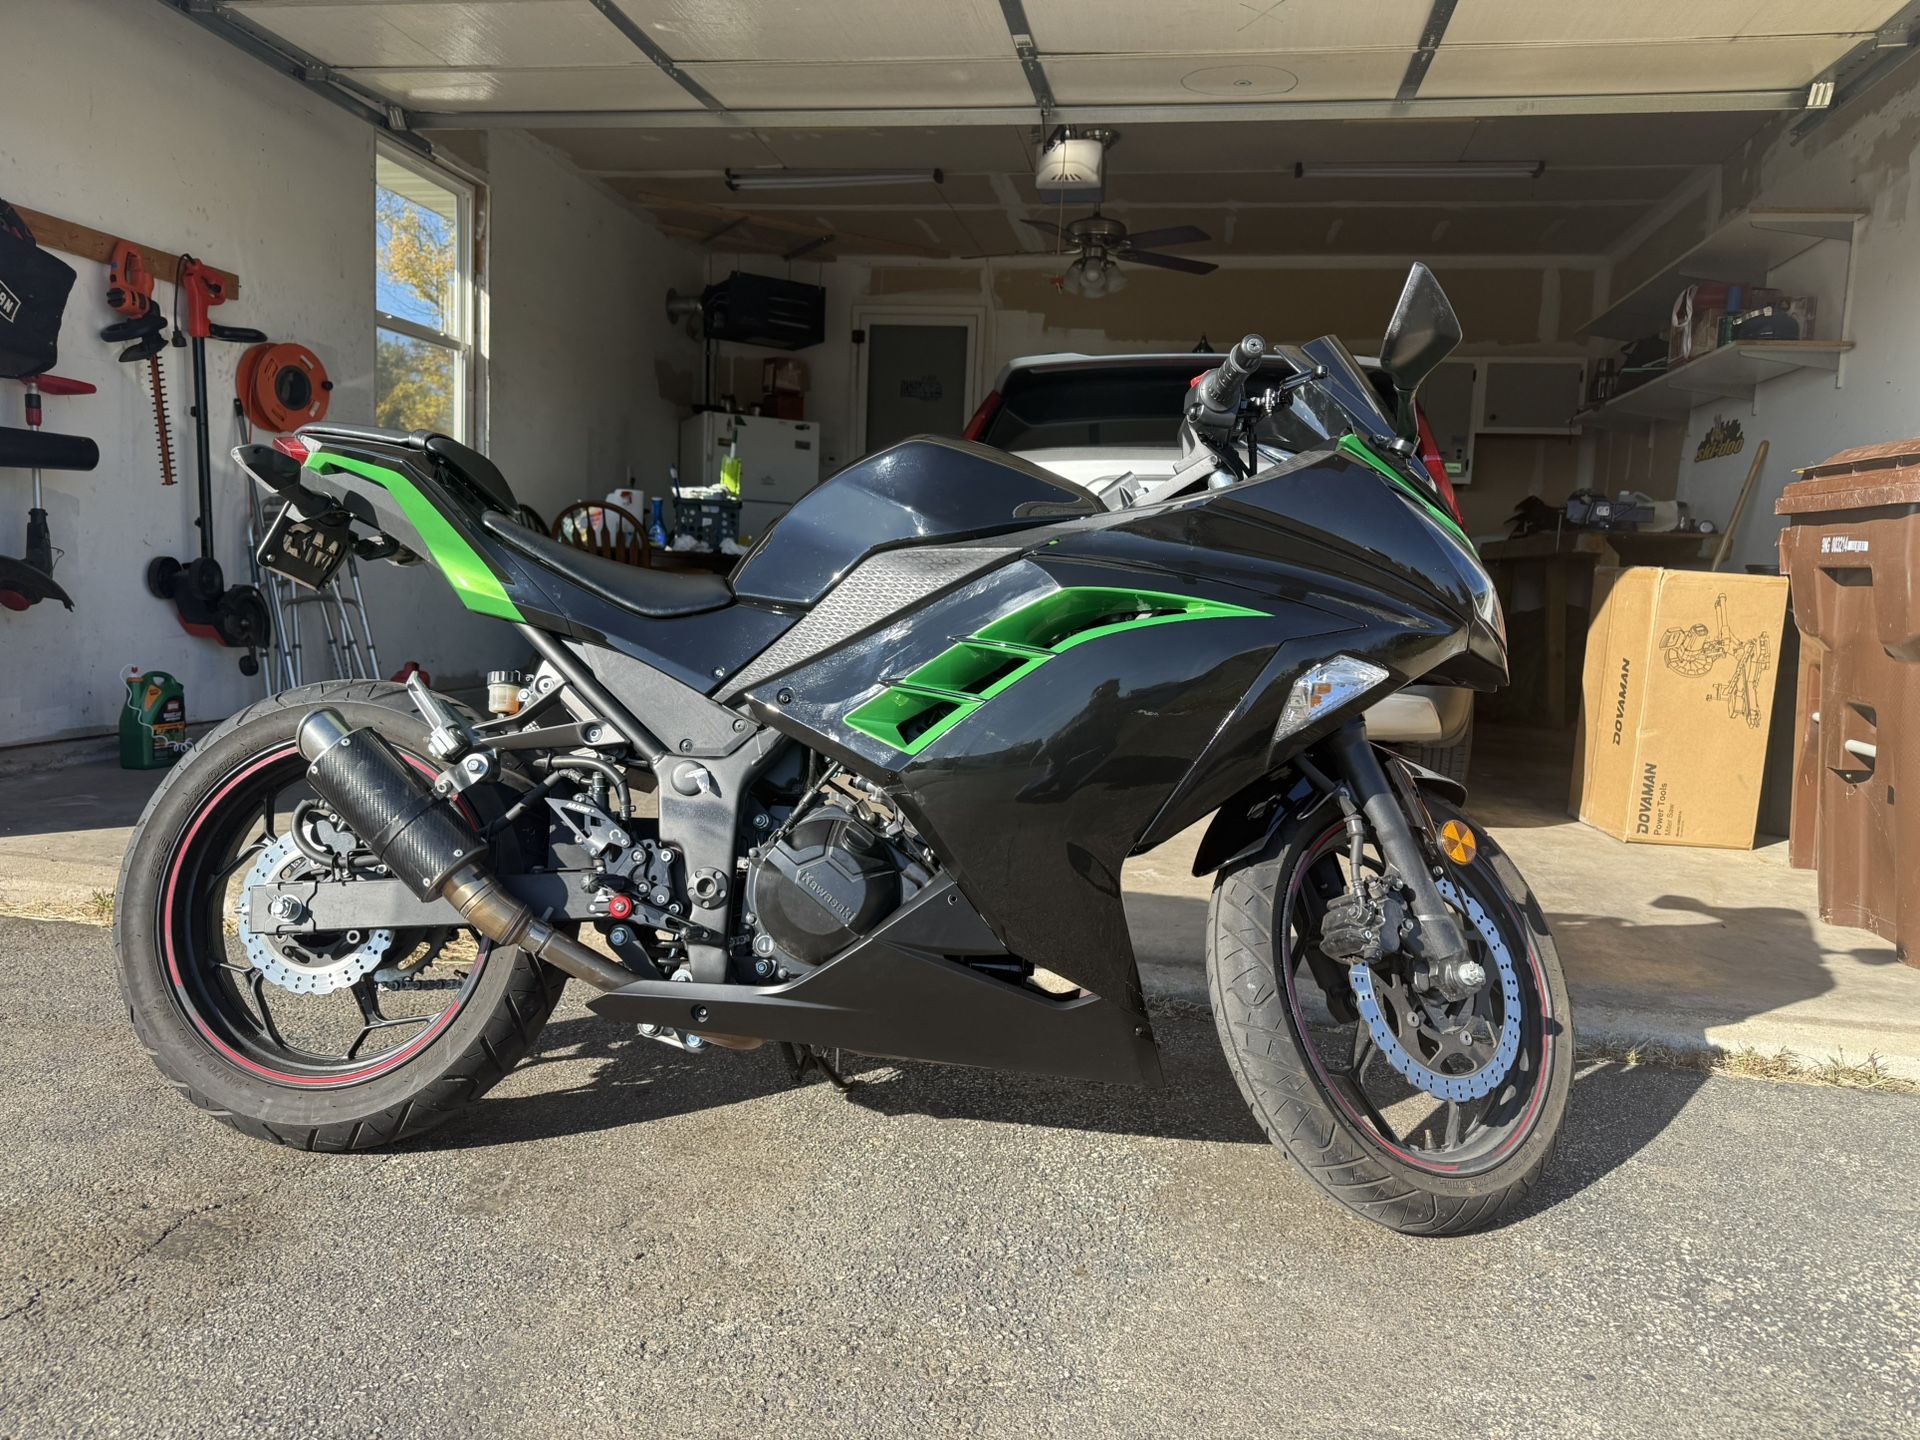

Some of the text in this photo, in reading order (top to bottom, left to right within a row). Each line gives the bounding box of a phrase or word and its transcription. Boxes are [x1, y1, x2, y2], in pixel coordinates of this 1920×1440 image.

[1613, 658, 1630, 745] DOVAMAN
[1637, 763, 1657, 834] DOVAMAN
[1654, 783, 1668, 836] Power Tools
[801, 870, 857, 922] Kawasaki
